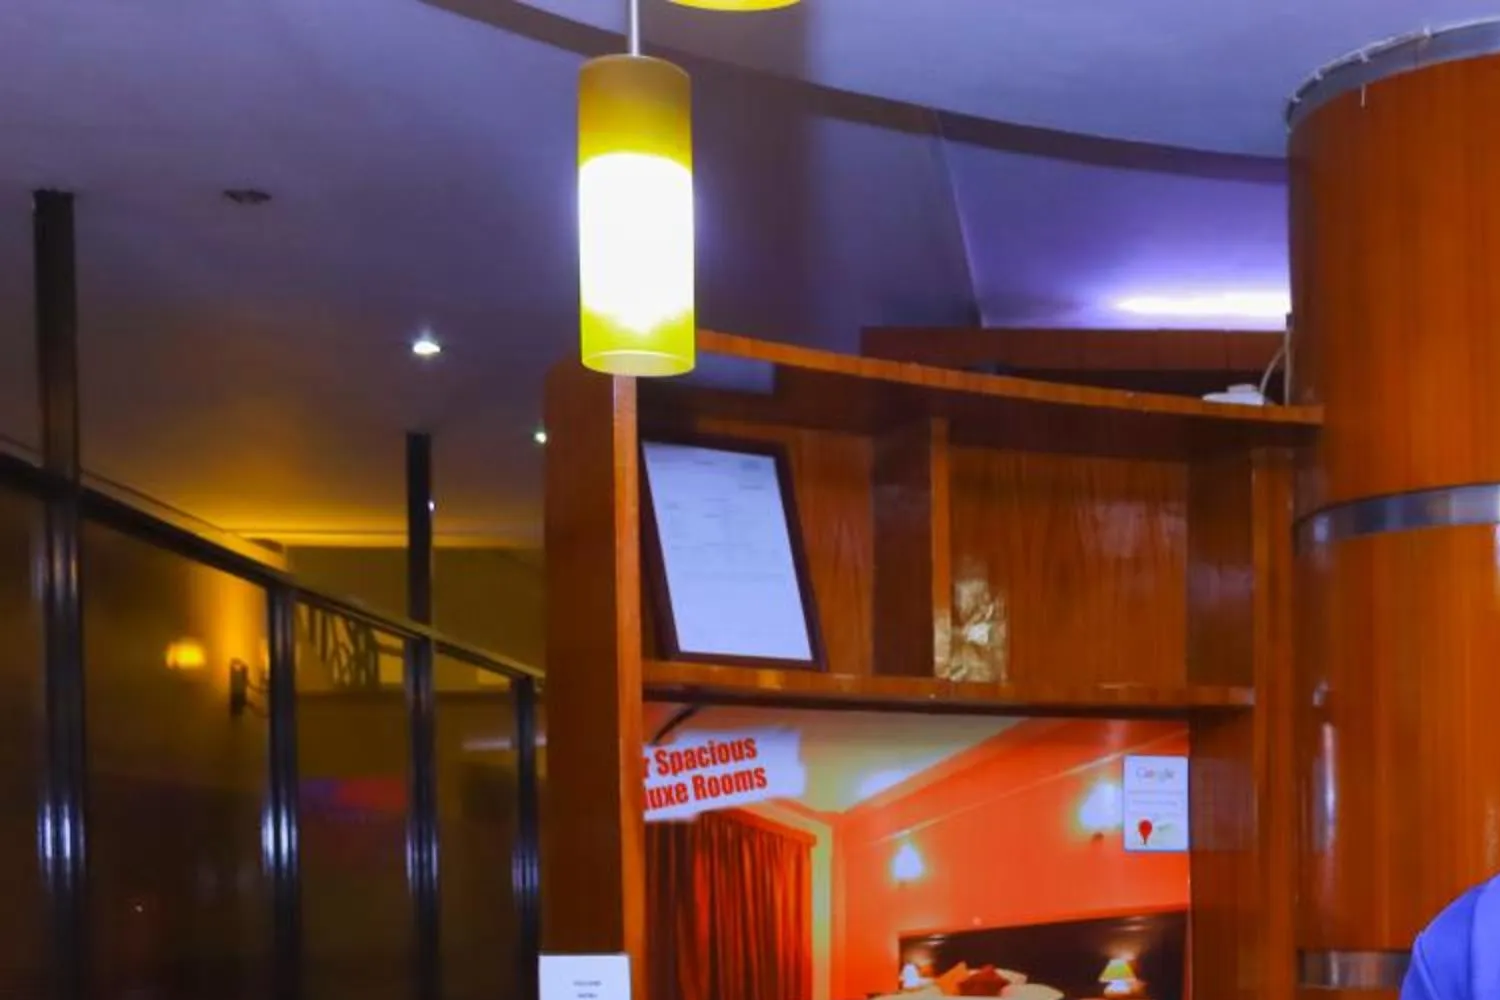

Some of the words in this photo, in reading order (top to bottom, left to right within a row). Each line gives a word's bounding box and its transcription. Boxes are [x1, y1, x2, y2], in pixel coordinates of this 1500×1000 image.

[654, 737, 758, 777] Spacious
[643, 781, 689, 811] luxe
[692, 766, 768, 801] Rooms
